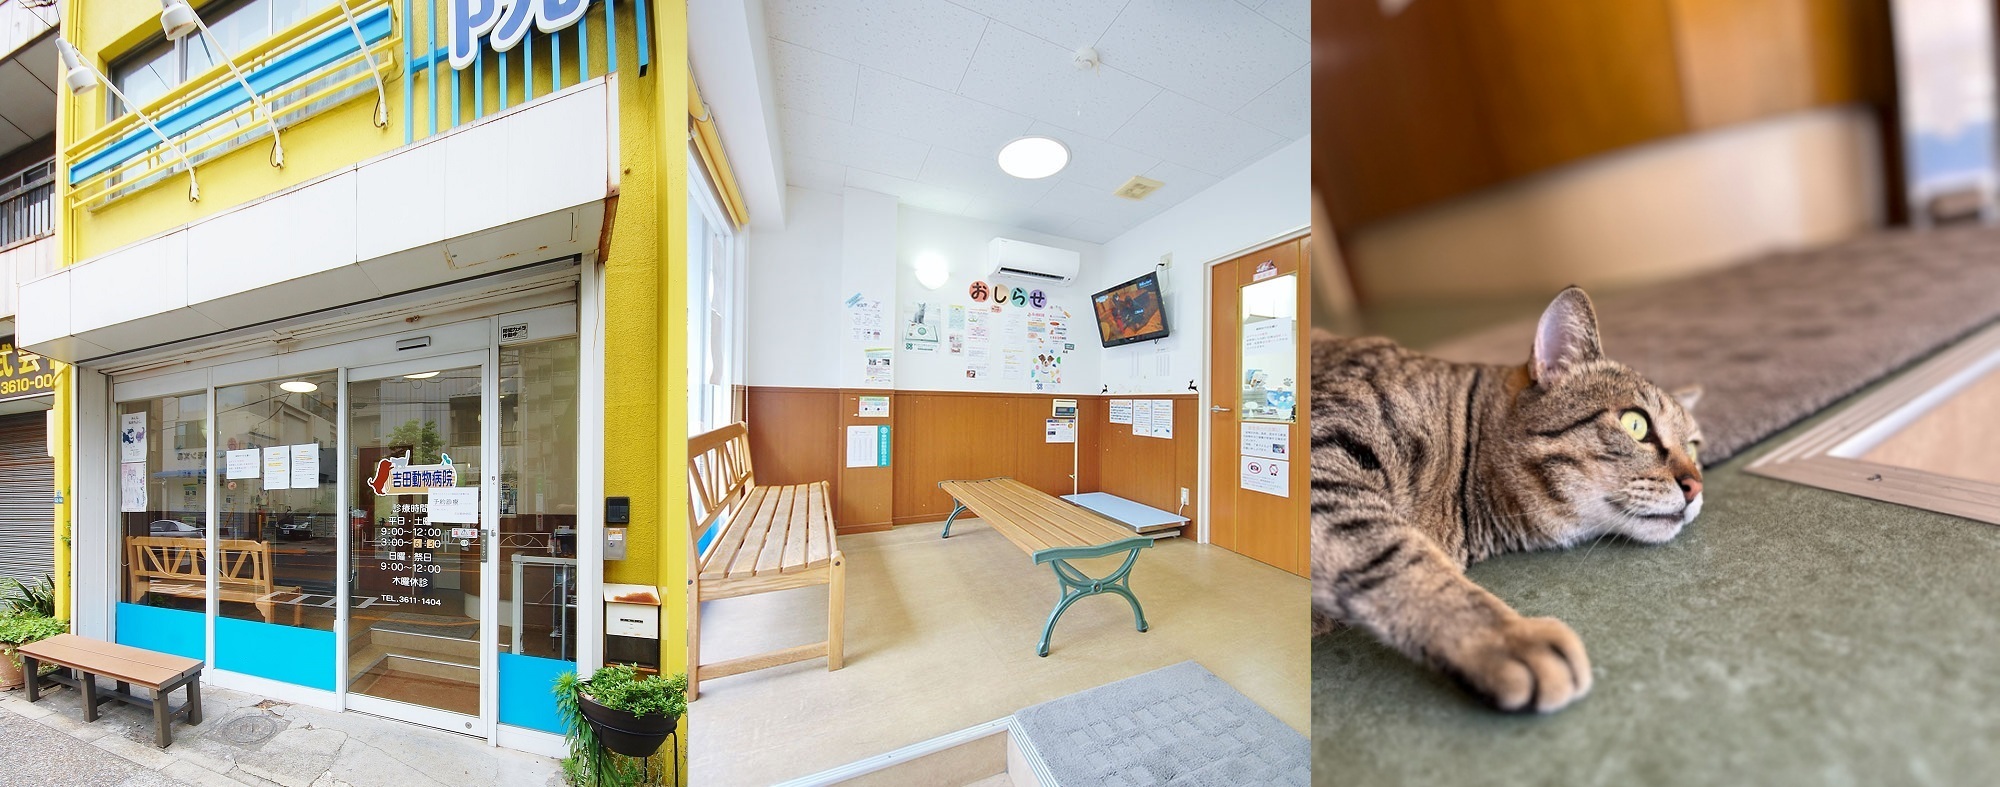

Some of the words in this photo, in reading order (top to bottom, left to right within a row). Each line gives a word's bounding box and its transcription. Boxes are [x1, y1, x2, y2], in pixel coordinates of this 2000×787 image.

[971, 282, 1045, 308] おしらせ
[0, 343, 55, 377] 式会
[392, 469, 453, 488] 吉田動物病院
[392, 503, 429, 513] 診療時間
[392, 576, 428, 588] 木曜休診
